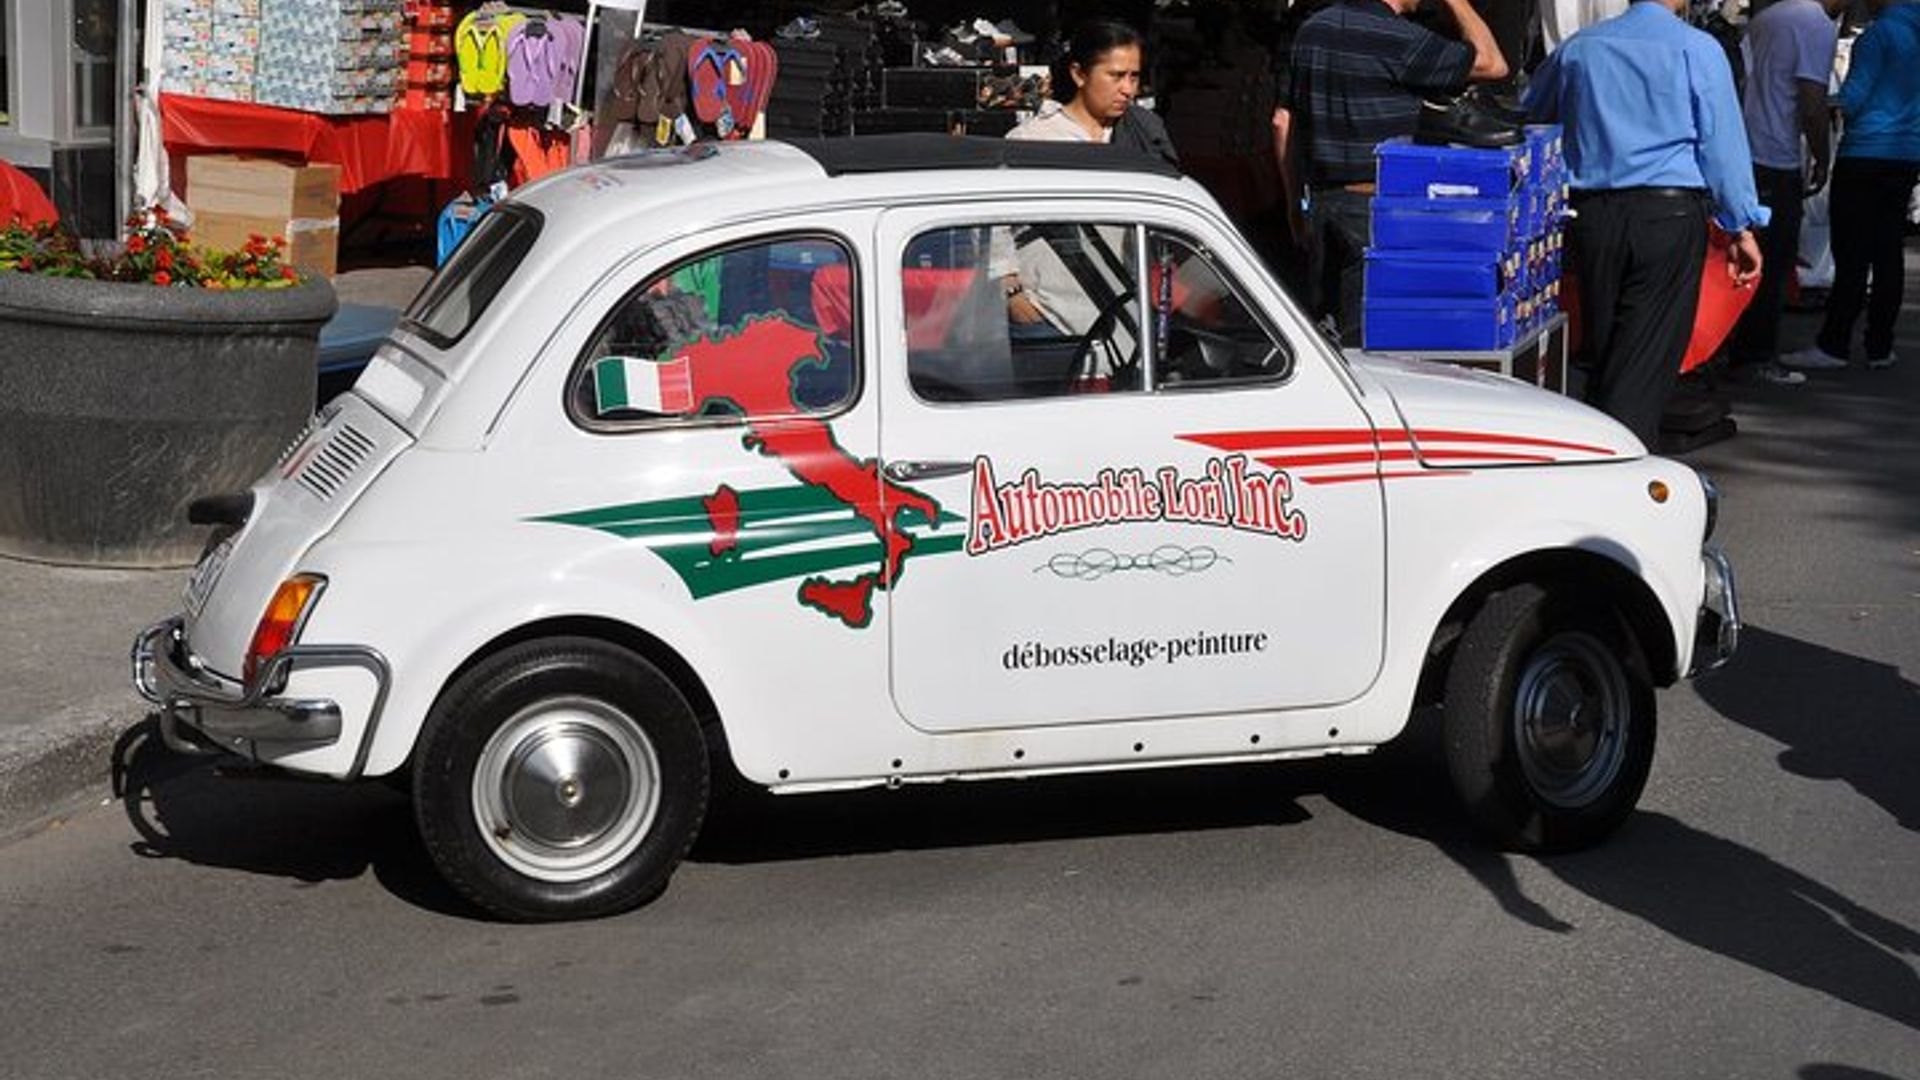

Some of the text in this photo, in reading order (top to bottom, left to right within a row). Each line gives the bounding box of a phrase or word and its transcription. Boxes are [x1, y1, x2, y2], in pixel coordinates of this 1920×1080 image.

[968, 453, 1307, 556] Automobile Lori Inc.
[1002, 630, 1269, 671] débosselage-peinture
